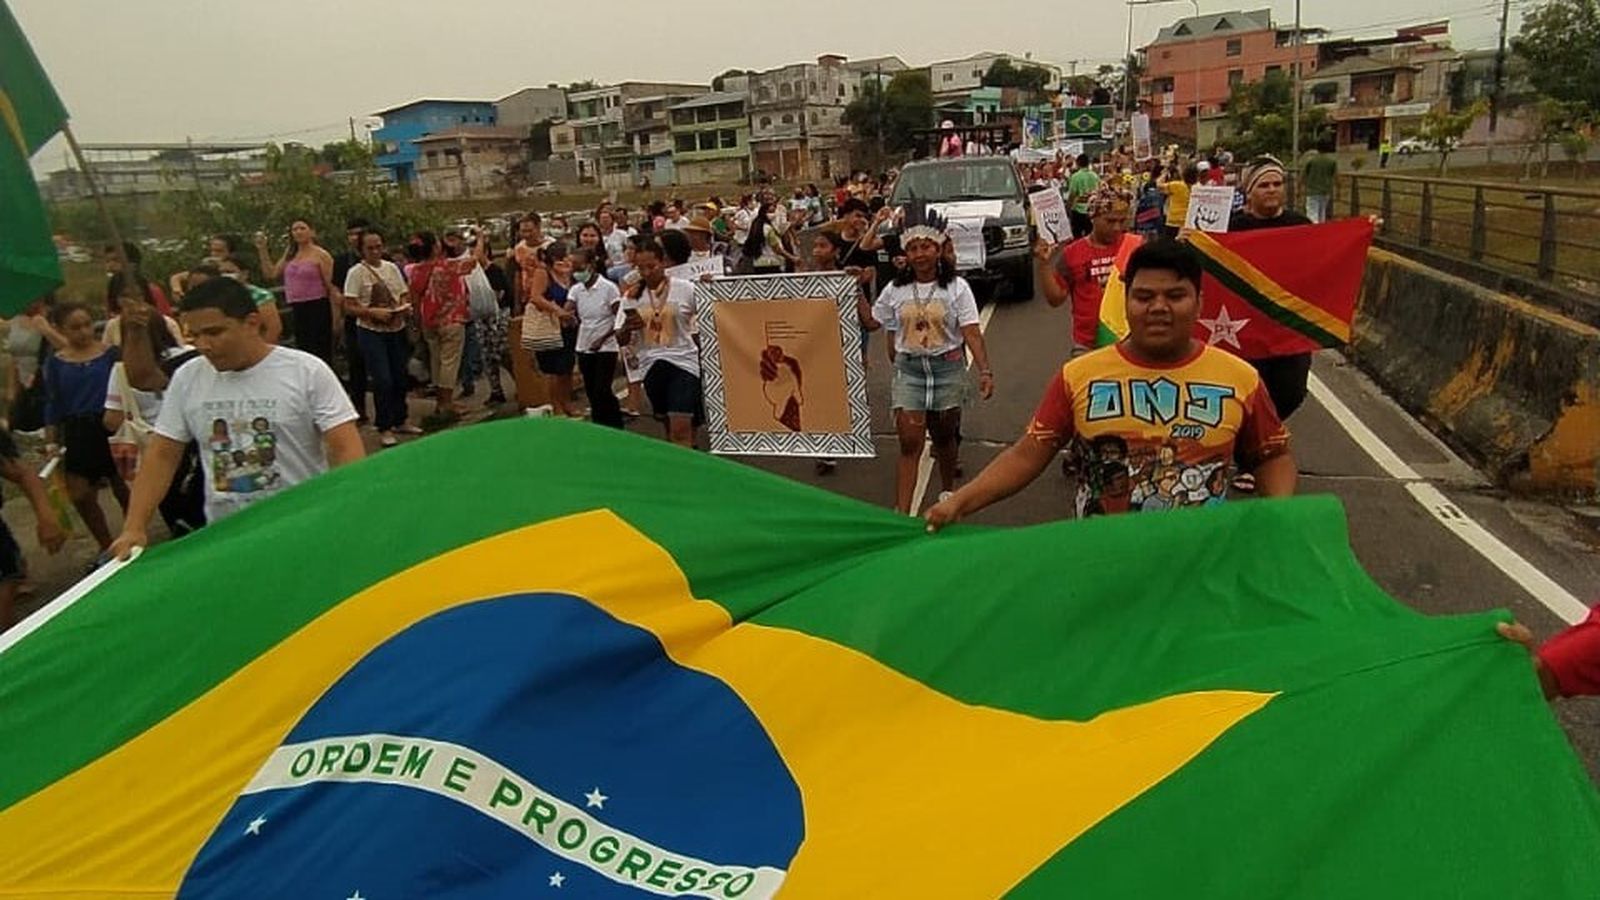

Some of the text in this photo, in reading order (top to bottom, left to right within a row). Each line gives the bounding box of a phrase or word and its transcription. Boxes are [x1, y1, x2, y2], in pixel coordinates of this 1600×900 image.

[1214, 324, 1234, 336] PT
[1170, 424, 1206, 439] 2019
[290, 742, 755, 899] ORDEM E PROGRESSO
